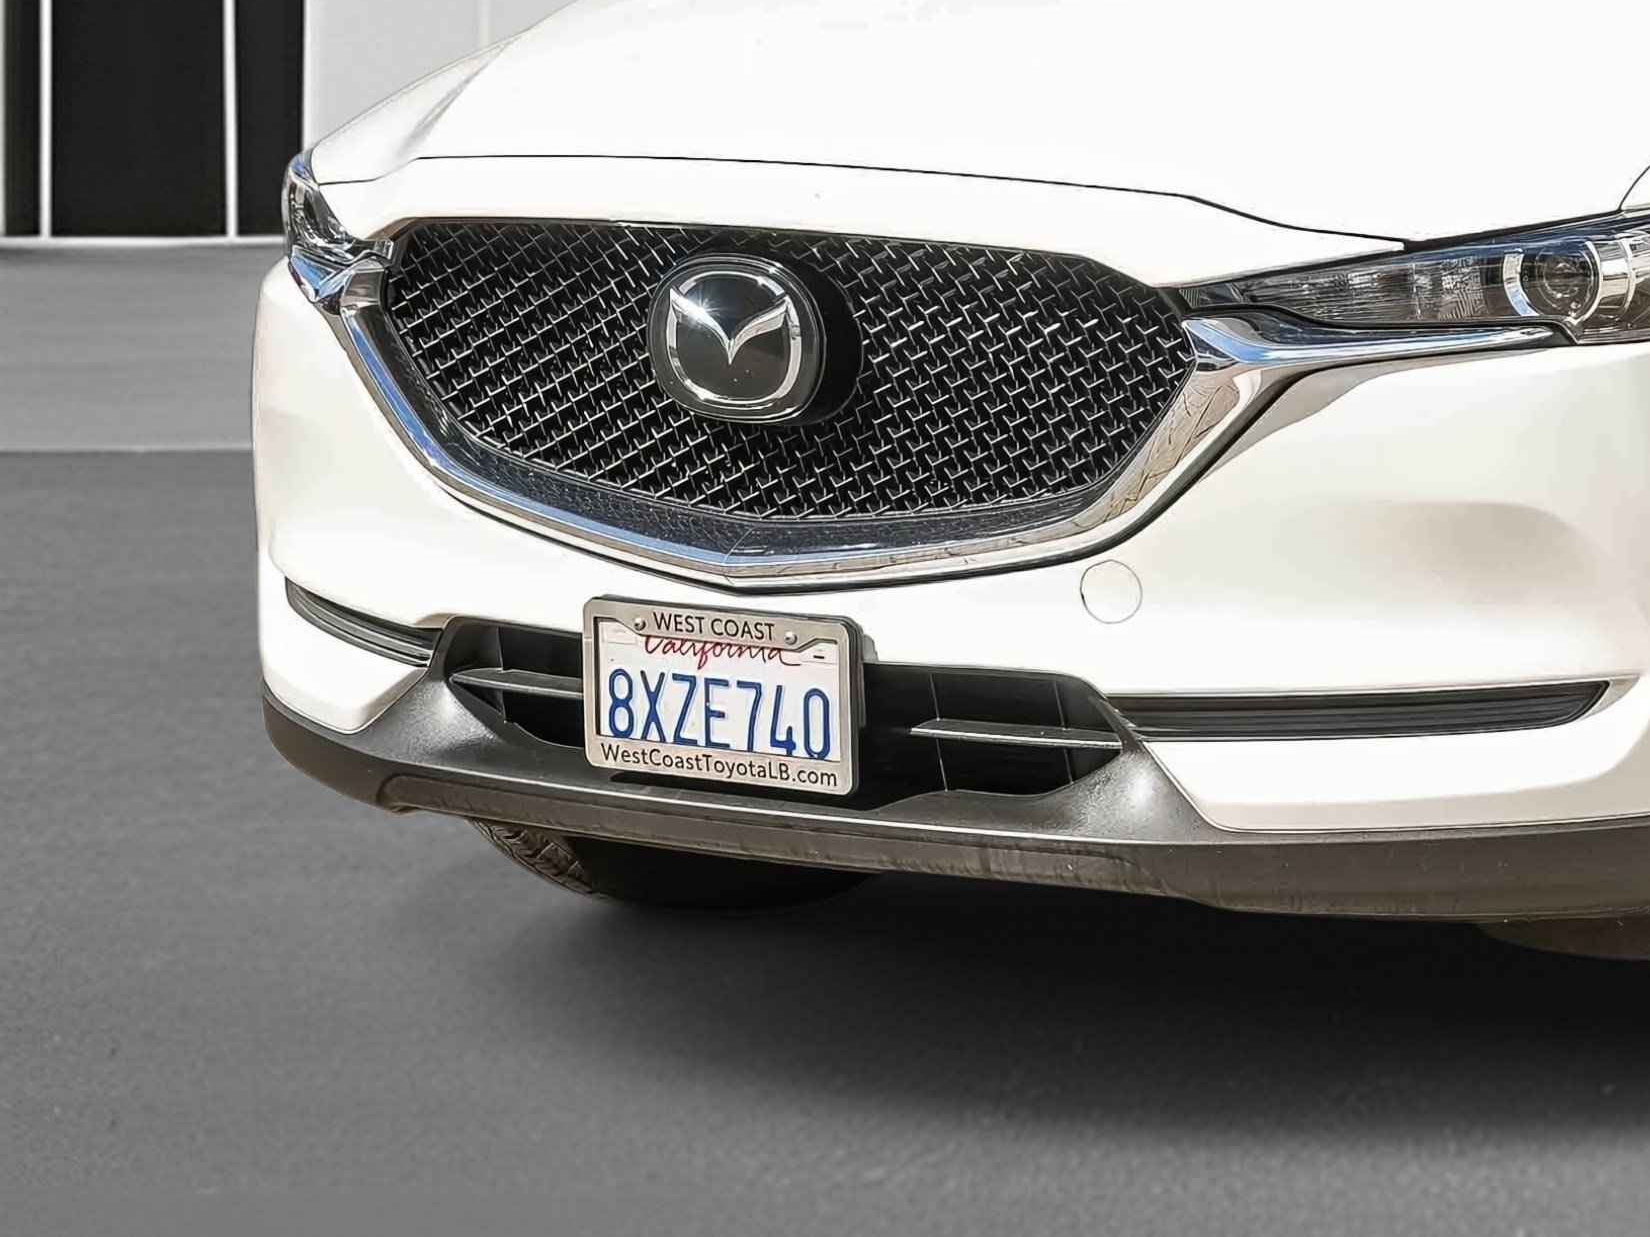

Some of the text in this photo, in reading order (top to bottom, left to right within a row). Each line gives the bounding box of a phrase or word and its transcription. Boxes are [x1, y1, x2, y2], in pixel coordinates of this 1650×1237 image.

[652, 612, 776, 642] WEST COAST
[607, 667, 832, 761] 8XZE740
[599, 742, 839, 788] WestCoastToyotaLB.com
